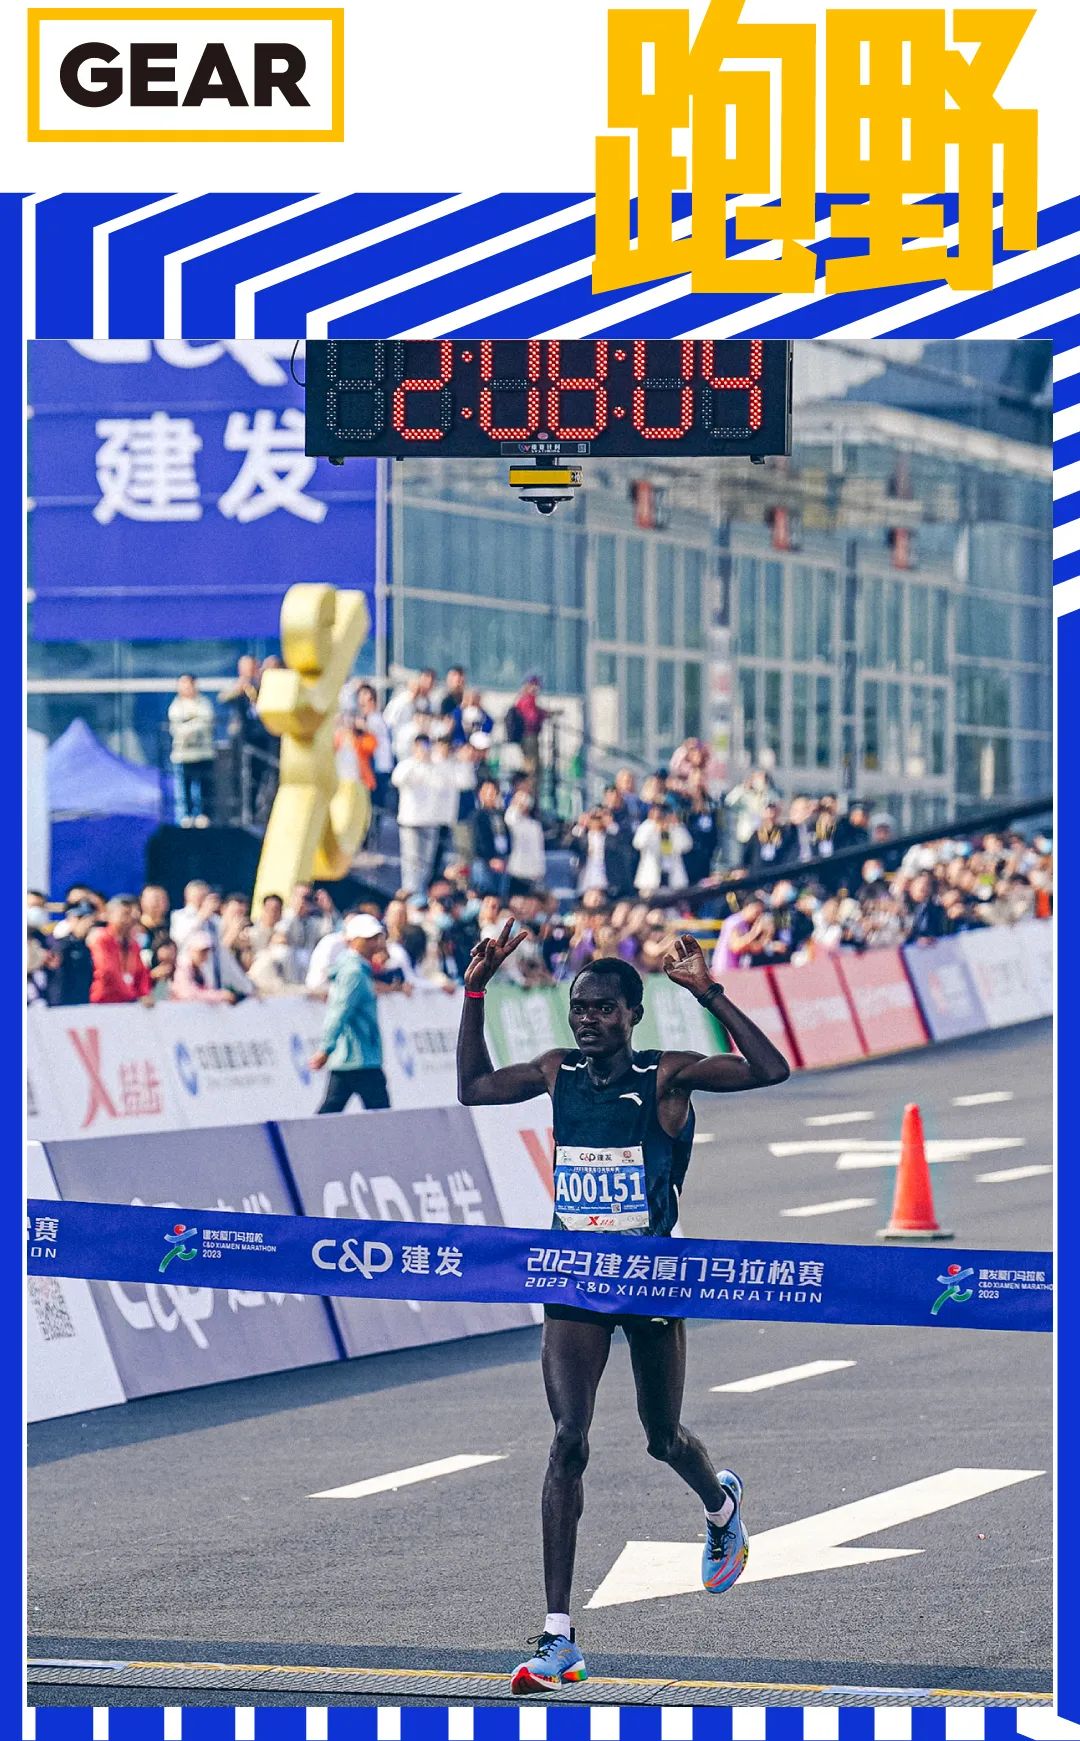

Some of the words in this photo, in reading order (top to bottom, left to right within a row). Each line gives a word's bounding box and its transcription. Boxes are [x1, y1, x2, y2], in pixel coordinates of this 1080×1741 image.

[93, 410, 328, 524] 建发
[556, 1172, 645, 1203] A00151
[202, 1229, 264, 1244] 建发厦门马拉松
[202, 1249, 222, 1259] 2023
[215, 1242, 240, 1250] XIAMEN
[241, 1244, 277, 1252] MARATHON
[311, 1238, 393, 1279] C&D
[401, 1244, 463, 1278] 建发
[527, 1247, 825, 1287] 2023建发厦门马拉松赛
[978, 1269, 1046, 1282] 建发厦门马拉松
[524, 1277, 568, 1288] 2023
[576, 1280, 611, 1294] C&D
[616, 1284, 692, 1298] XIAMEN
[700, 1288, 822, 1303] MARATHON
[993, 1282, 1020, 1290] XIAMEN
[978, 1289, 1000, 1299] 2023
